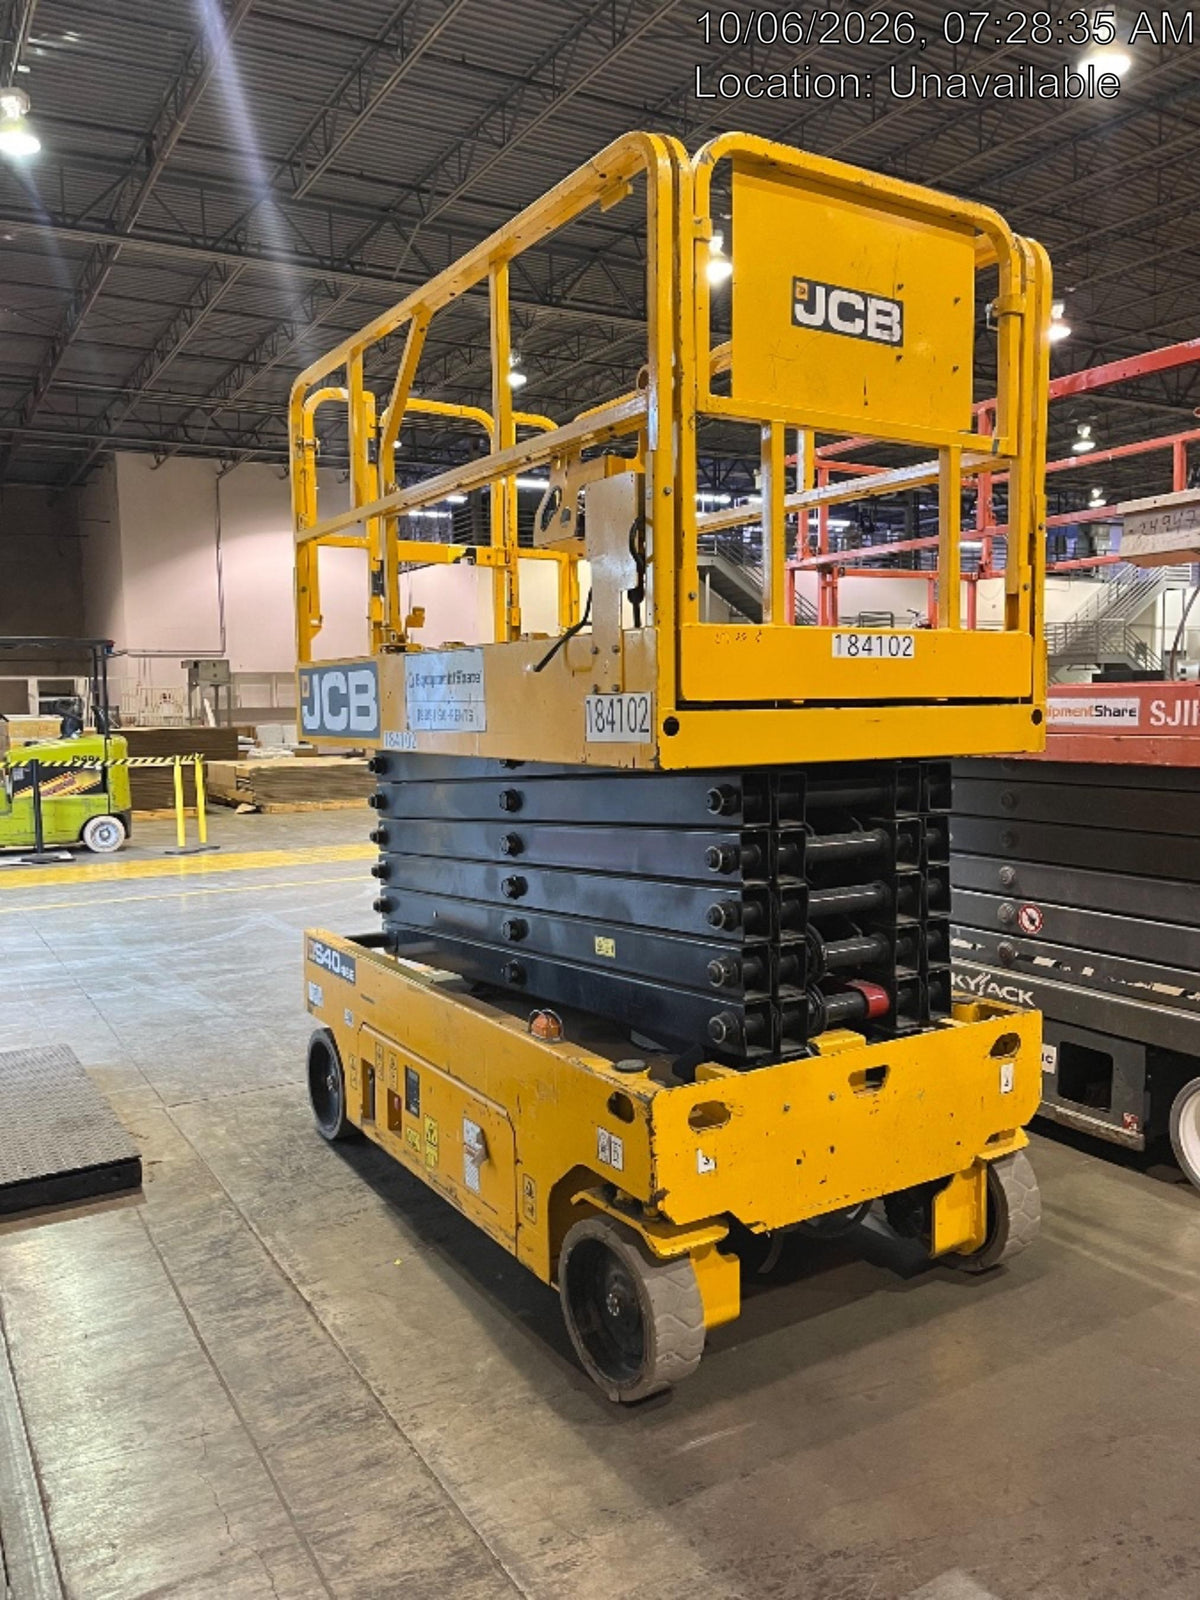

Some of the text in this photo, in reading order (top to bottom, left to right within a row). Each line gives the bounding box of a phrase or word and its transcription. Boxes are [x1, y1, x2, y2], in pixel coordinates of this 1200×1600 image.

[794, 284, 903, 343] JCB
[834, 633, 913, 657] 184102
[302, 669, 378, 732] JCB
[586, 697, 651, 734] 184102
